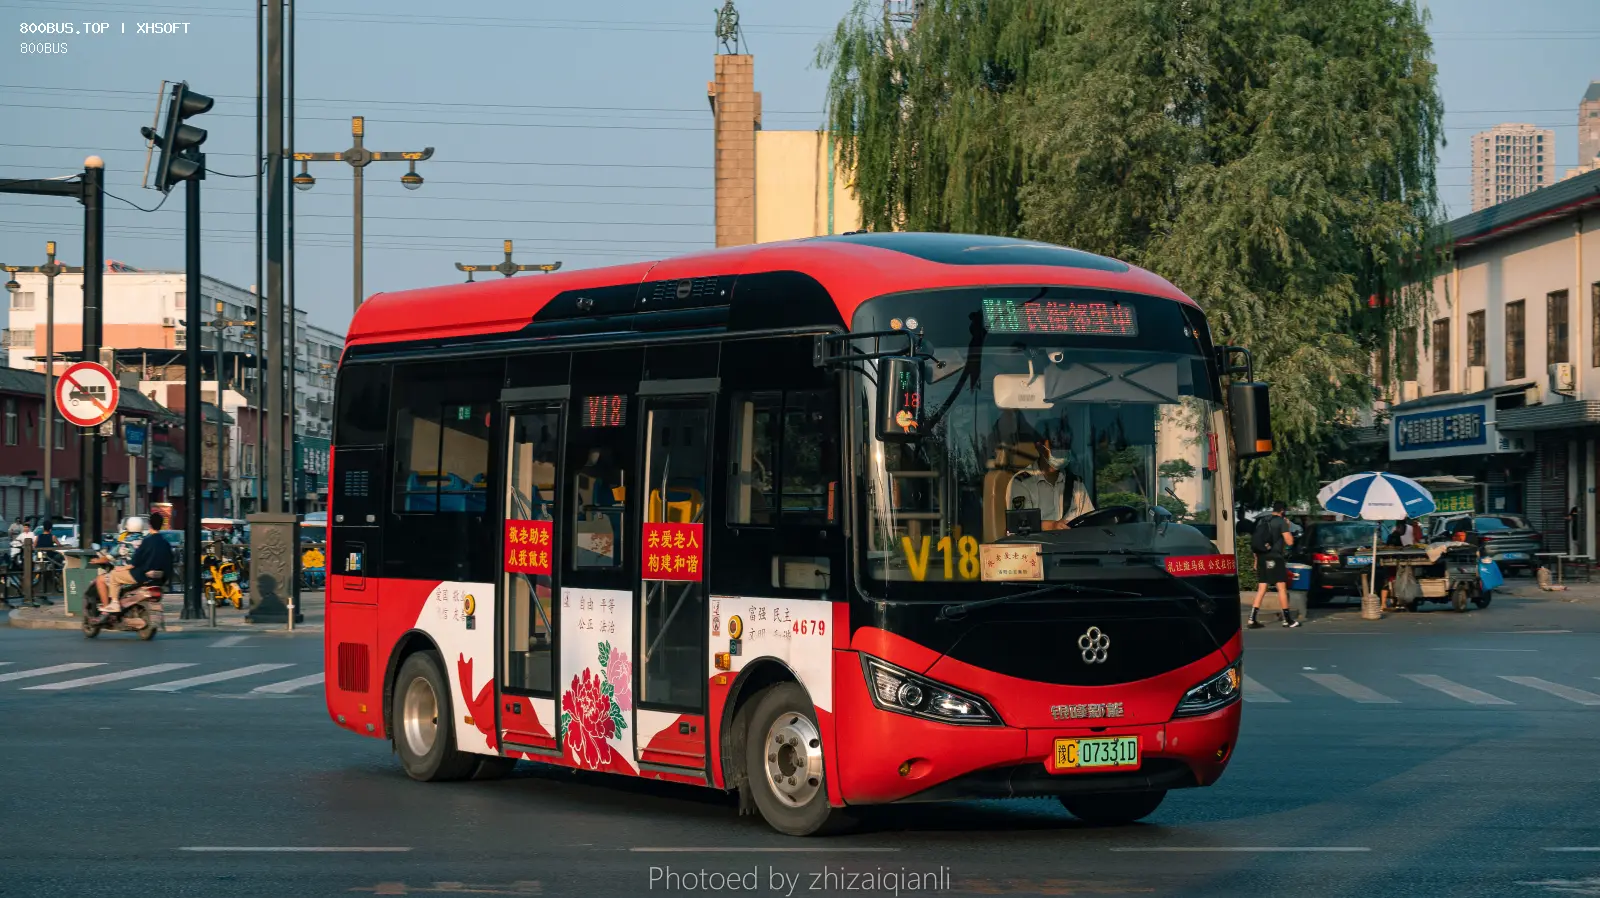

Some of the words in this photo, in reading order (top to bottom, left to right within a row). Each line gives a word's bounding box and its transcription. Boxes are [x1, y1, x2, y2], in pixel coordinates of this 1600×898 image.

[903, 391, 921, 408] 18
[588, 395, 622, 426] V18
[509, 526, 550, 547] 敬老助老
[647, 529, 699, 550] 关爱老人
[508, 548, 549, 569] 从我做起
[647, 553, 699, 574] 构建和谐
[901, 535, 979, 581] V18
[1167, 559, 1206, 573] 礼让斑马线
[748, 605, 767, 622] 富强
[773, 607, 791, 623] 民主
[792, 619, 826, 636] 4679
